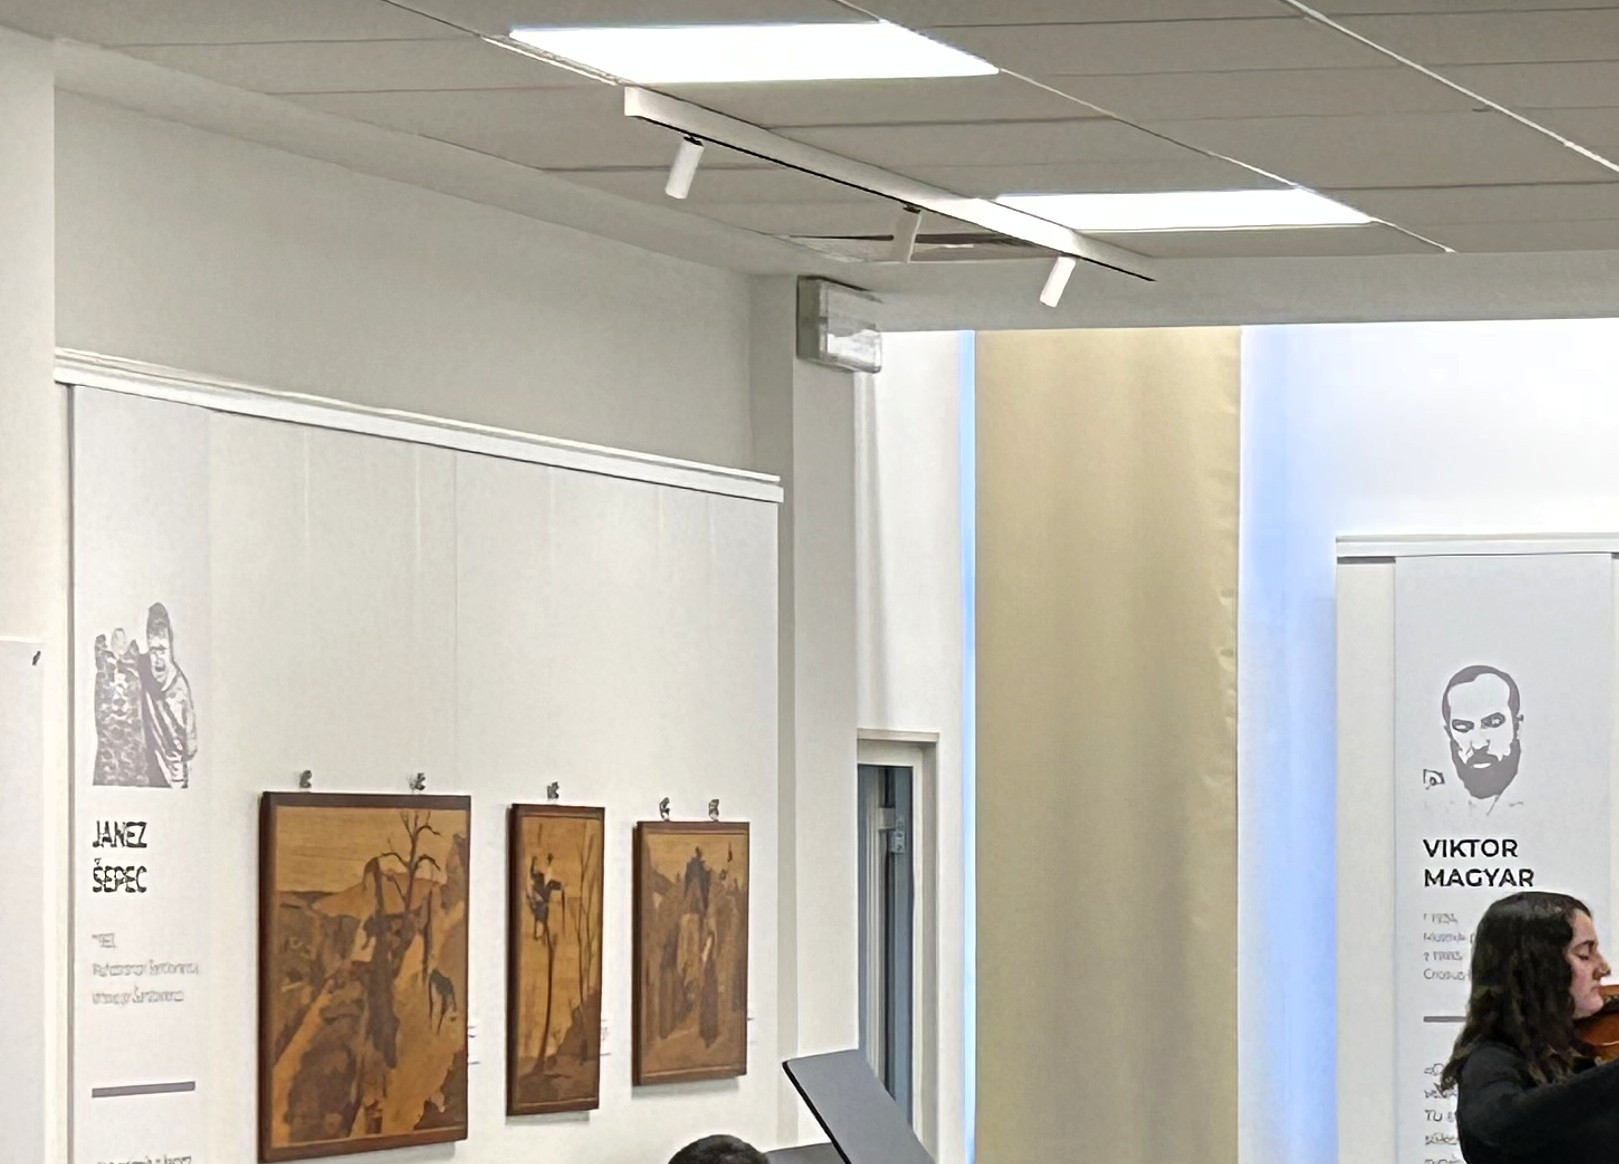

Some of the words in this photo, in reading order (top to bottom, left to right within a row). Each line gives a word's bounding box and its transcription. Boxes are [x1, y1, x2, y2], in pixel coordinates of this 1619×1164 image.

[92, 820, 147, 848] JANEZ
[1423, 838, 1518, 858] VIKTOR
[92, 857, 147, 893] ŠEPEC
[1424, 868, 1534, 887] MAGYAR
